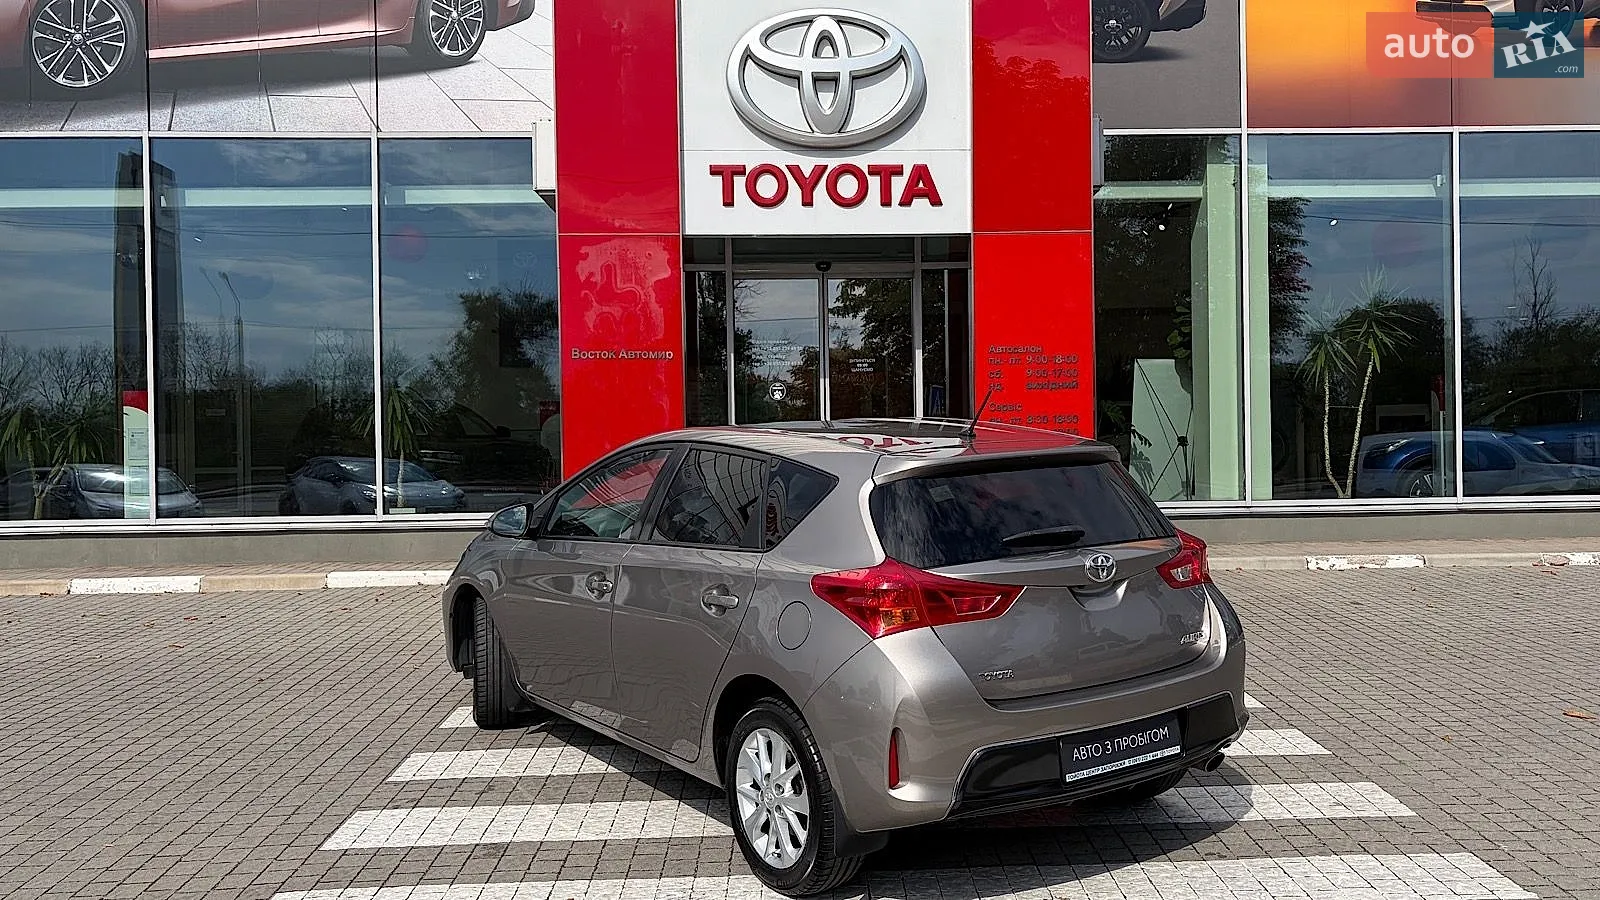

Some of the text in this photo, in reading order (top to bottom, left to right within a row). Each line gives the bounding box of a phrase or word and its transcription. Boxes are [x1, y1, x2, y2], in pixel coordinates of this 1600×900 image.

[709, 163, 944, 209] TOYOTA
[571, 347, 674, 360] Восток Автомир
[988, 345, 1043, 354] Автосалон
[989, 402, 1023, 411] Сервіс
[978, 669, 1015, 681] TOYOTA
[1072, 743, 1103, 762] АВТО
[1114, 726, 1170, 752] ПРОБІГОМ
